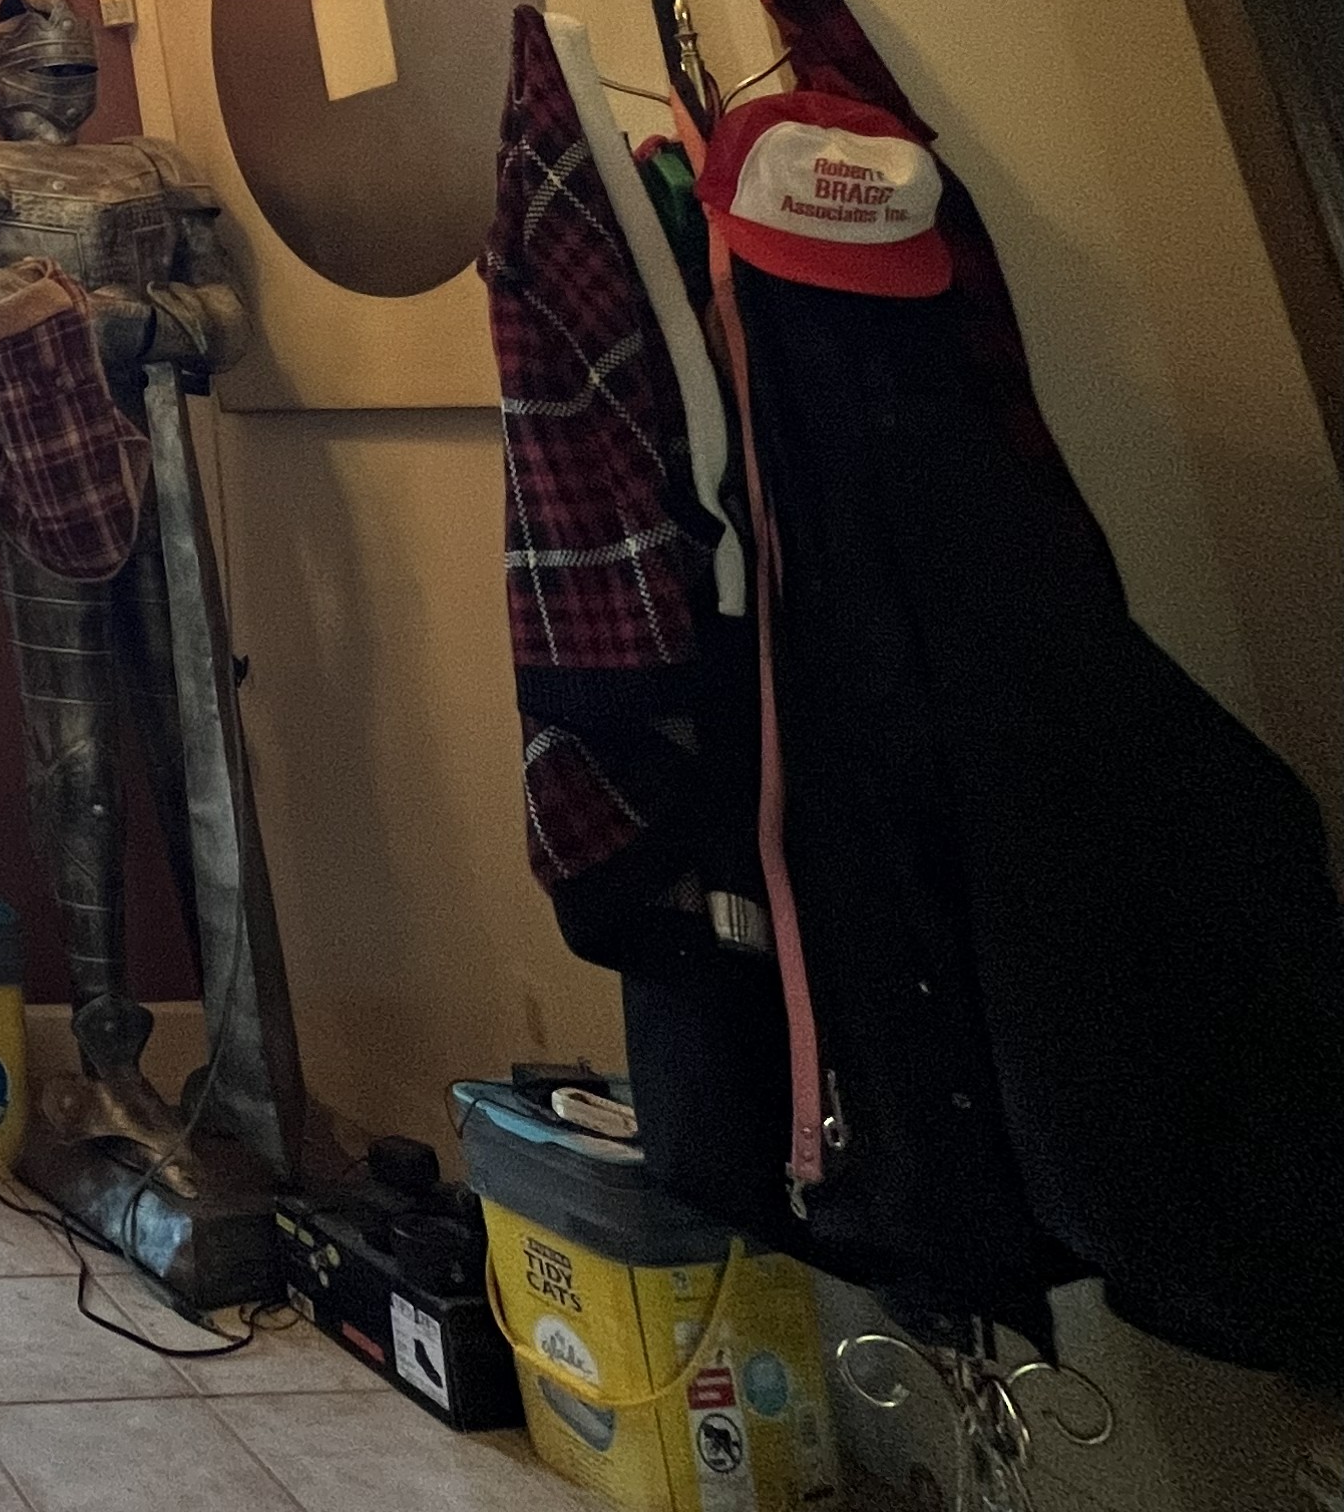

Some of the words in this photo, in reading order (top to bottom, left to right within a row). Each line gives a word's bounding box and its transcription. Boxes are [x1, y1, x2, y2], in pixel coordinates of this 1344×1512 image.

[814, 178, 895, 205] BRAGG
[780, 195, 878, 223] Associates
[523, 1249, 572, 1289] TIDY
[526, 1271, 582, 1313] CATS
